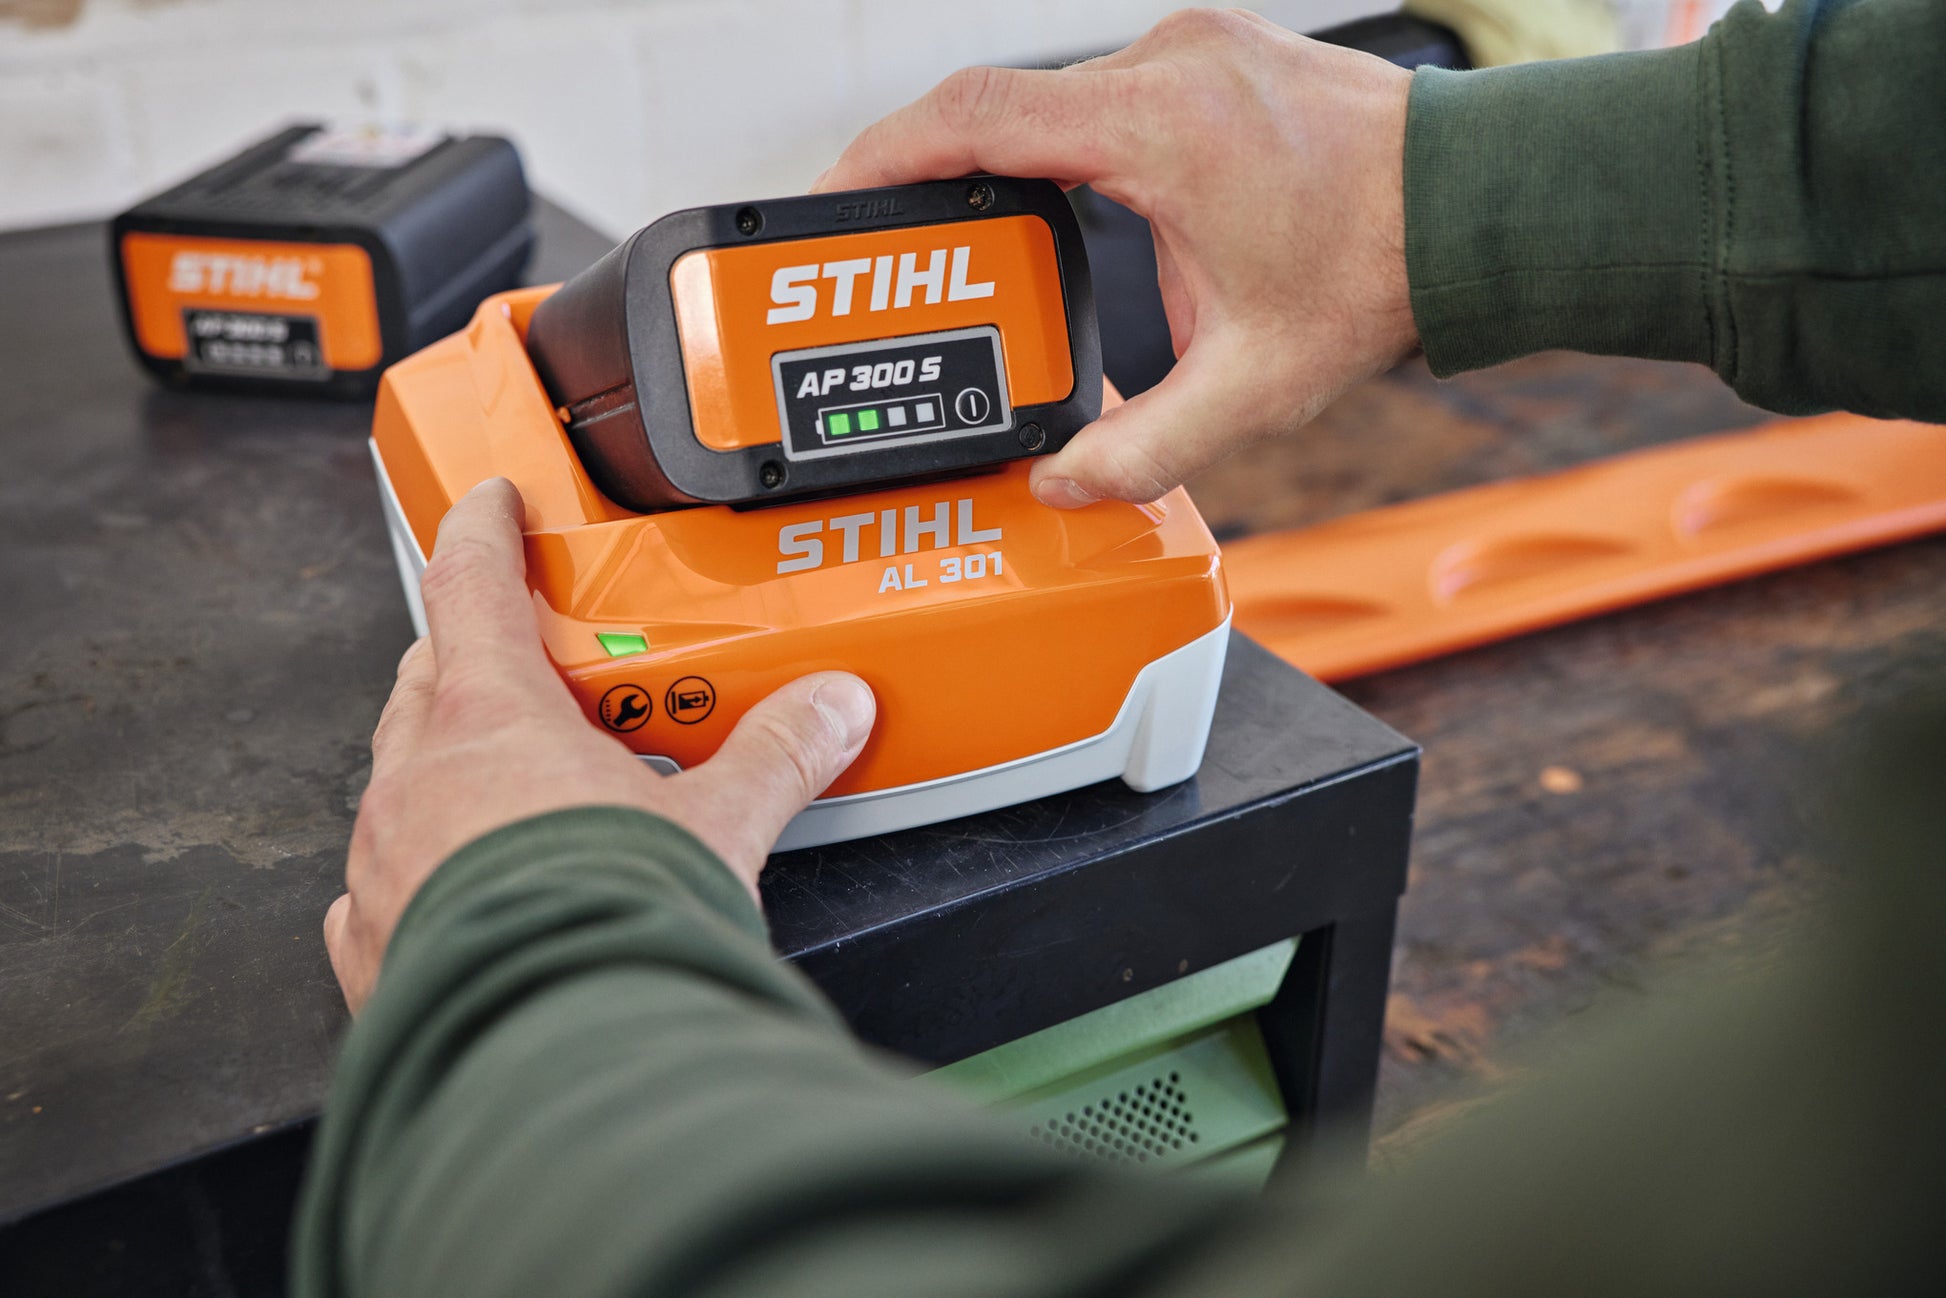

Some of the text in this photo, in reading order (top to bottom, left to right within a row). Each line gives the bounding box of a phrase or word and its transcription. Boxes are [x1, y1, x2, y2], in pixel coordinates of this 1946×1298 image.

[835, 198, 904, 223] STIHL
[767, 246, 996, 325] STIHL
[797, 356, 943, 399] AP 300 S
[777, 498, 1002, 574] STIHL
[878, 551, 1003, 593] AL 301
